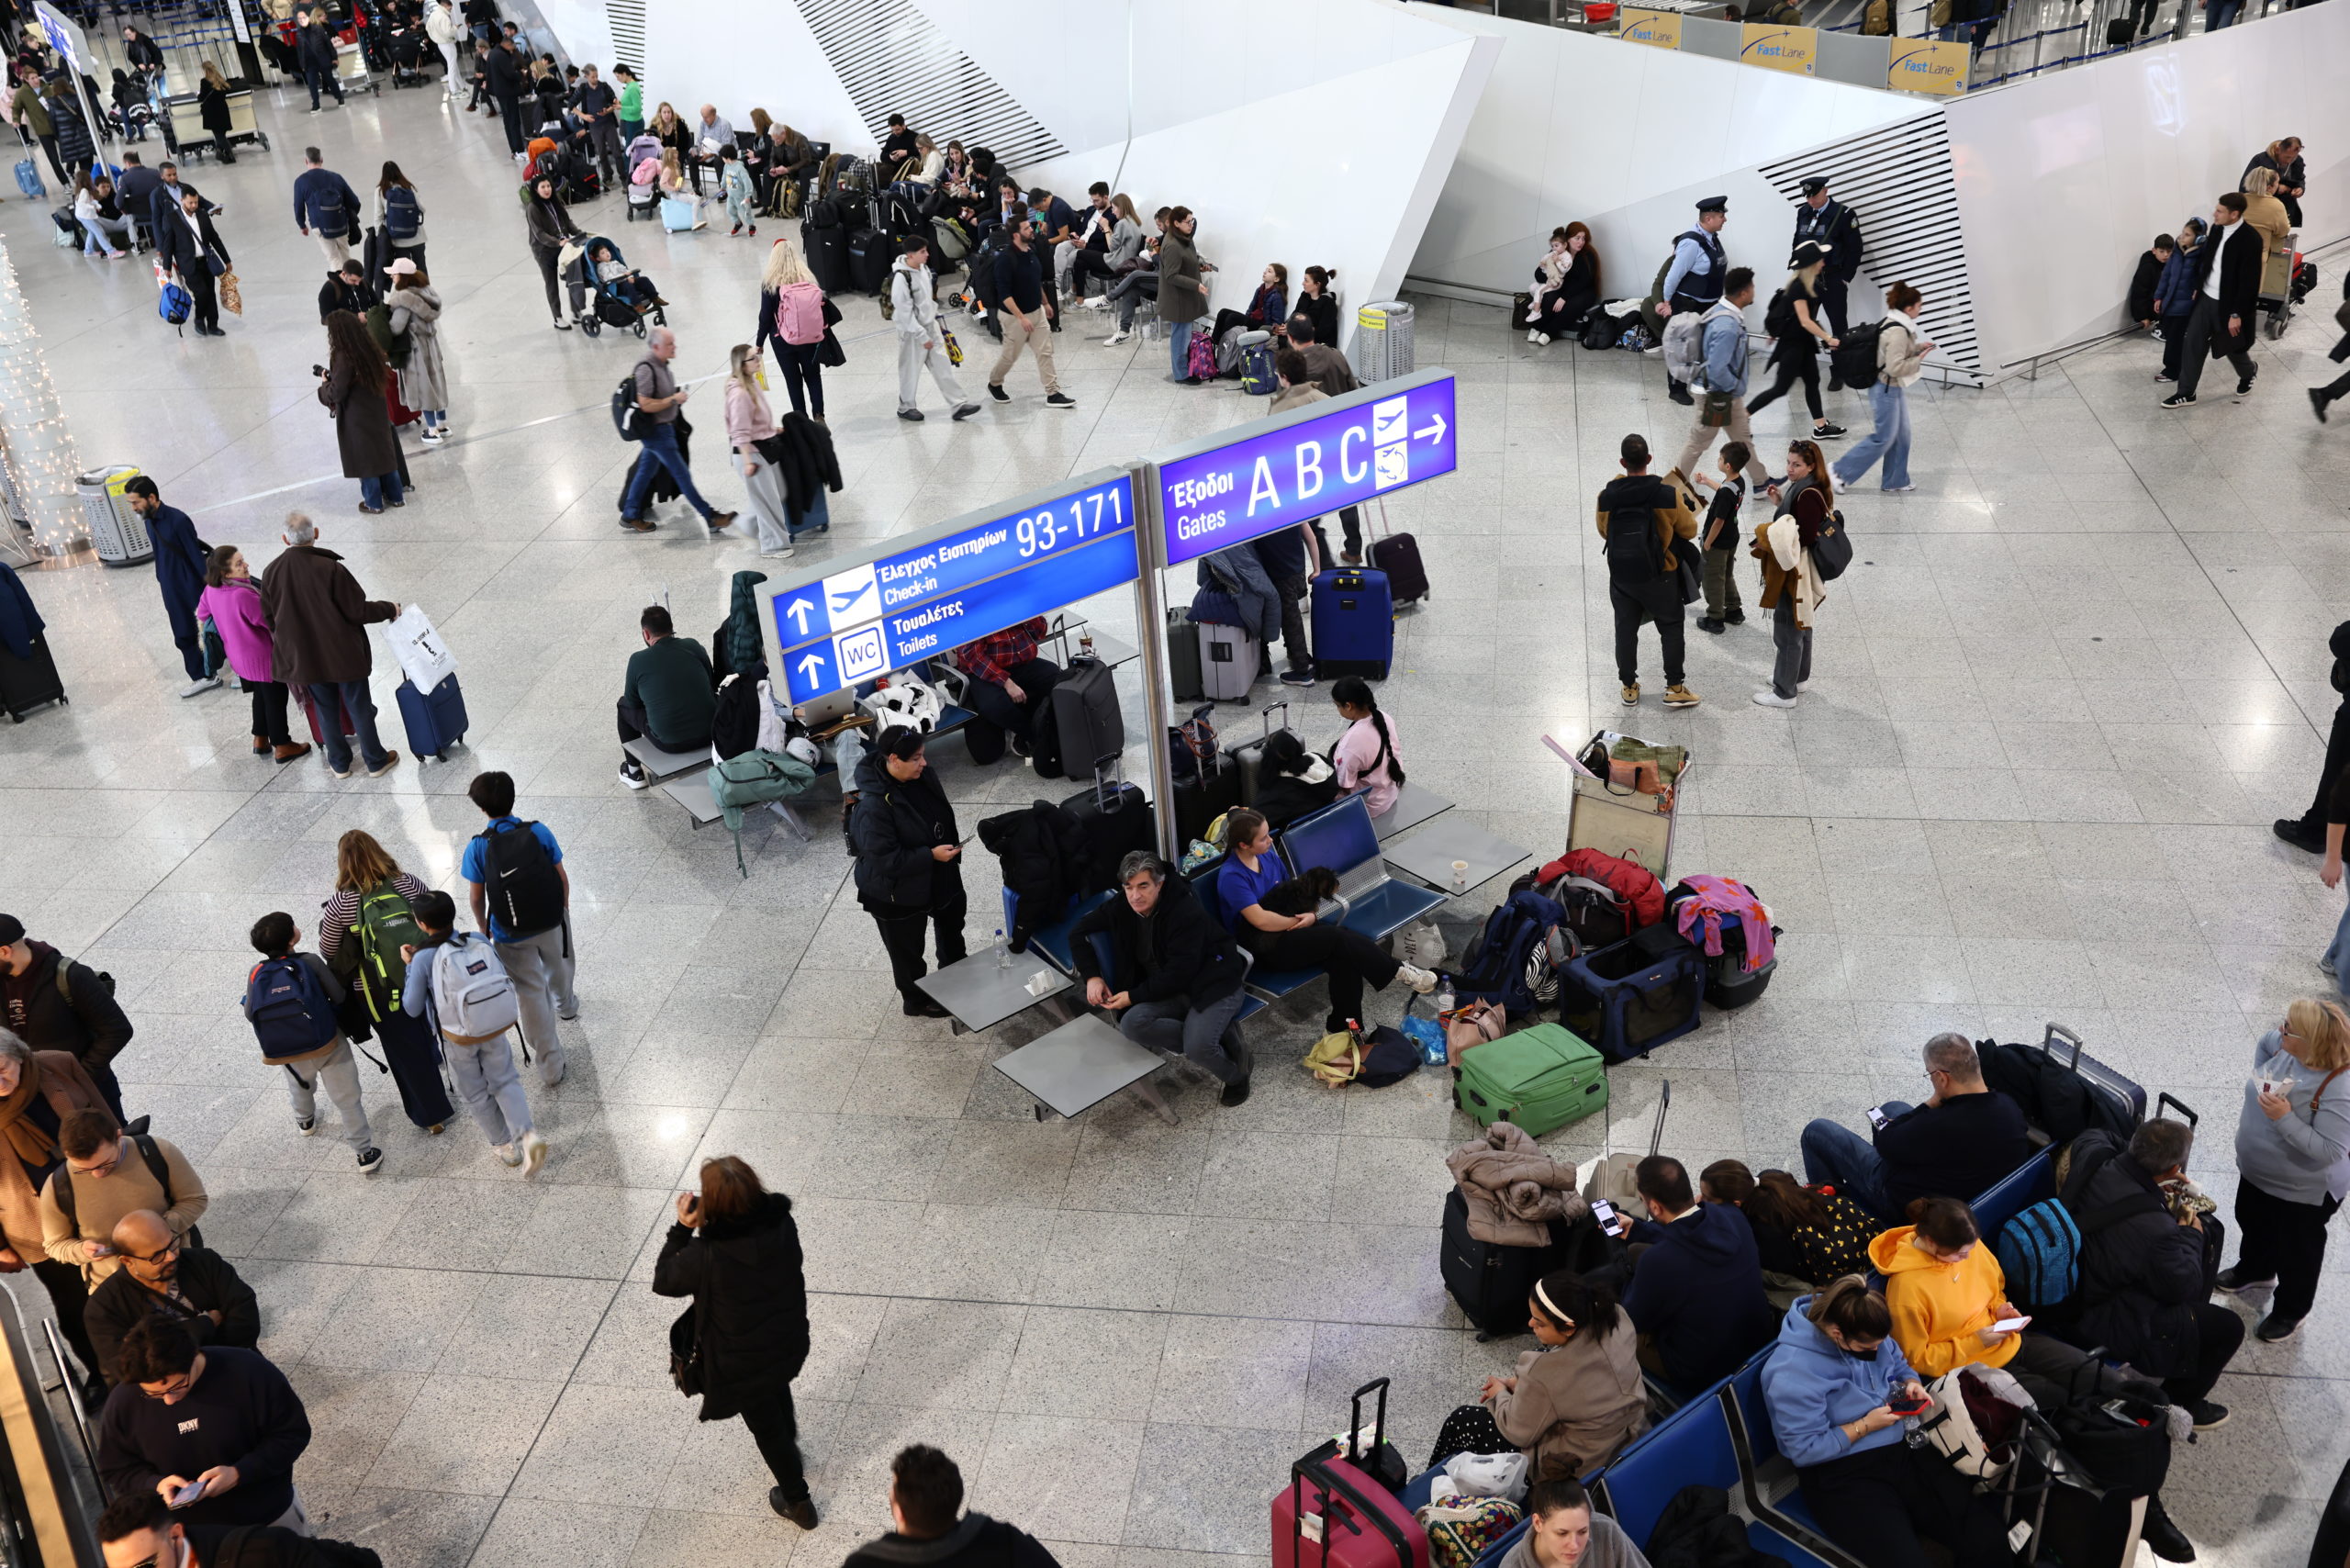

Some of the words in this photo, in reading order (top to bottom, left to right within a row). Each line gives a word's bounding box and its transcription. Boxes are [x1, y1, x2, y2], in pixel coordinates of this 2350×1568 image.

[1632, 28, 1651, 40] Fast
[1652, 30, 1673, 42] Lane
[1757, 44, 1781, 56] Fast
[1782, 46, 1806, 60] Lane
[1904, 60, 1928, 73] Fast
[1929, 63, 1954, 76] Lane
[1247, 455, 1281, 518] A
[1295, 441, 1324, 500] B
[1340, 426, 1368, 484] C
[1168, 472, 1234, 509] Έξοδοι
[1016, 487, 1122, 557] 93-171
[1178, 510, 1226, 540] Gates
[877, 554, 937, 583] Έλεγχος
[938, 529, 1007, 564] Εισιτηρίων
[884, 577, 937, 605] Check-in
[892, 600, 964, 635] Τουαλέτες
[847, 642, 877, 665] WC
[896, 633, 938, 657] Toilets
[177, 1417, 198, 1432] DKNY
